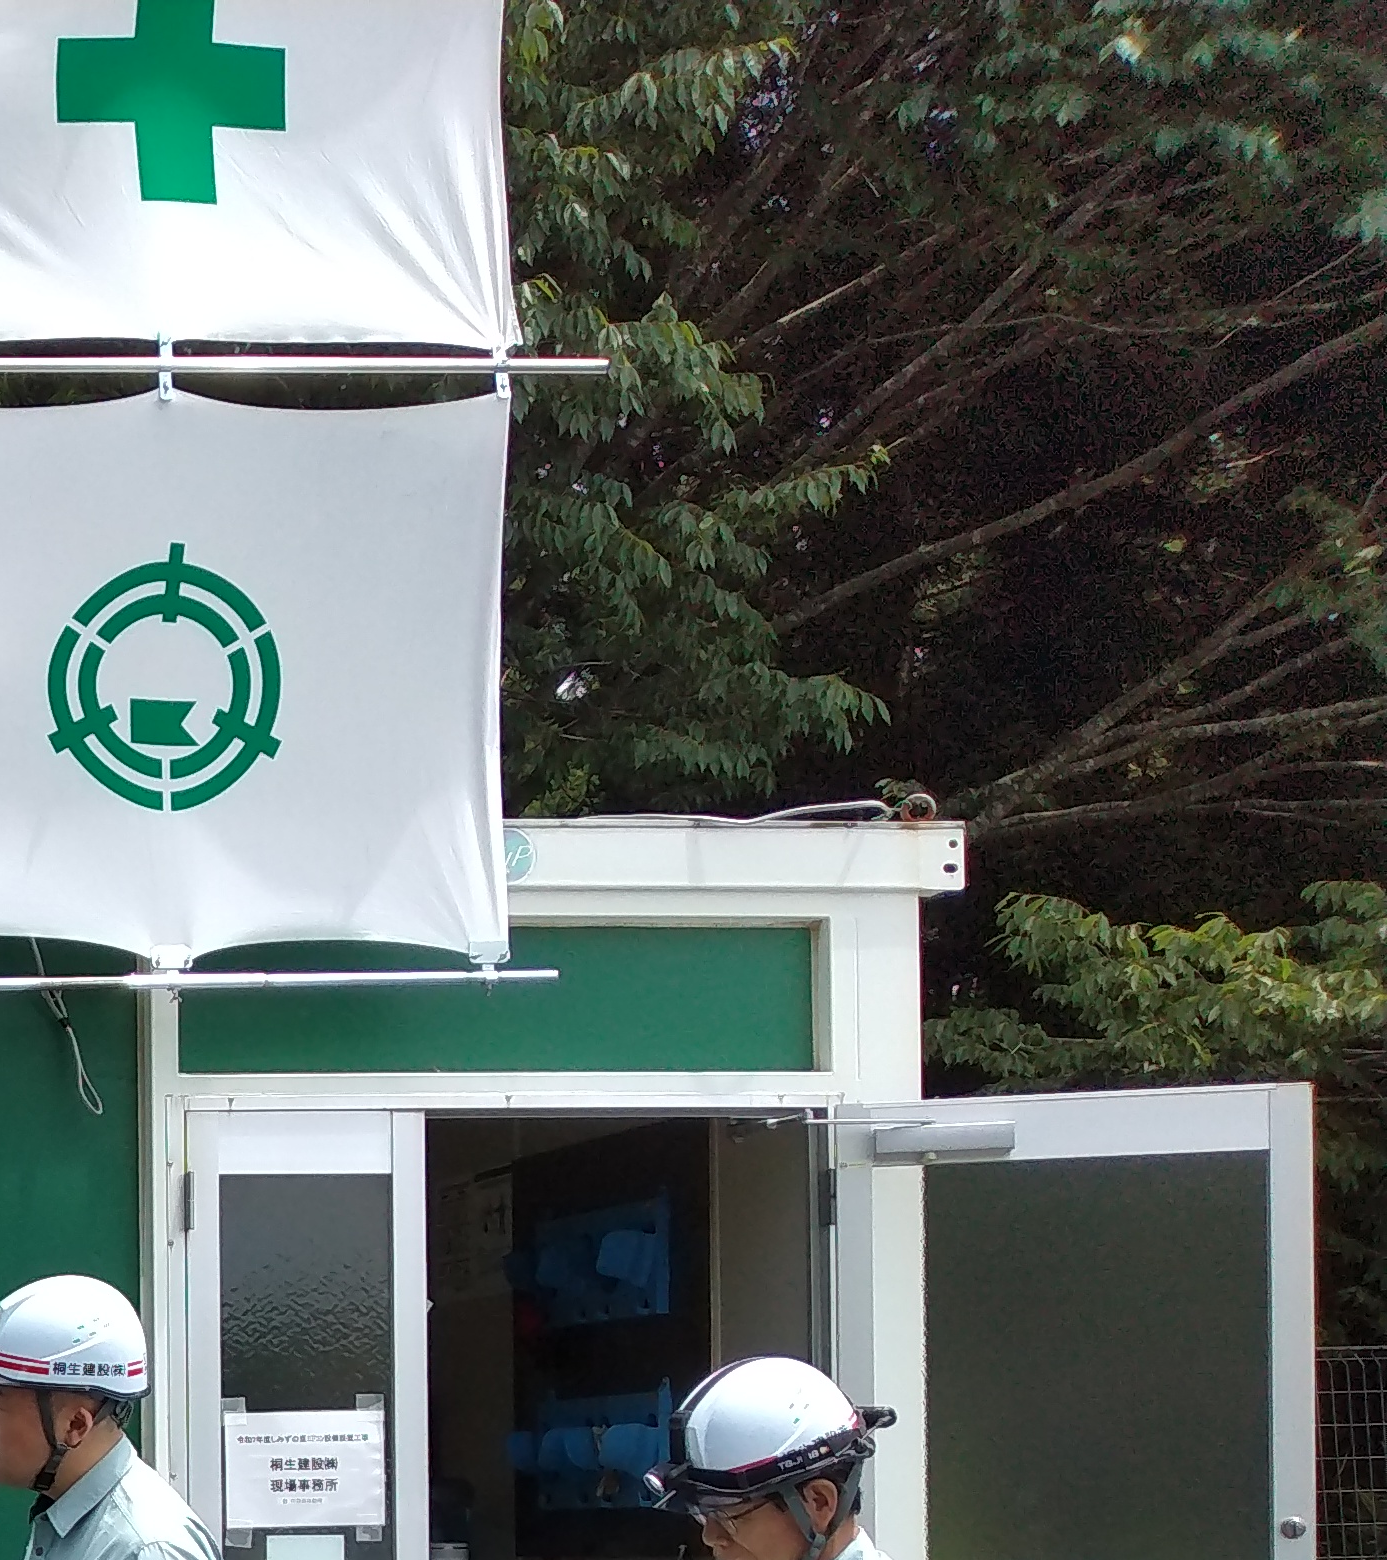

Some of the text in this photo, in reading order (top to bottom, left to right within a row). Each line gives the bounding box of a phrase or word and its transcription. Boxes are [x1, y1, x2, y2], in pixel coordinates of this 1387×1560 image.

[270, 1478, 339, 1492] 現場事務所
